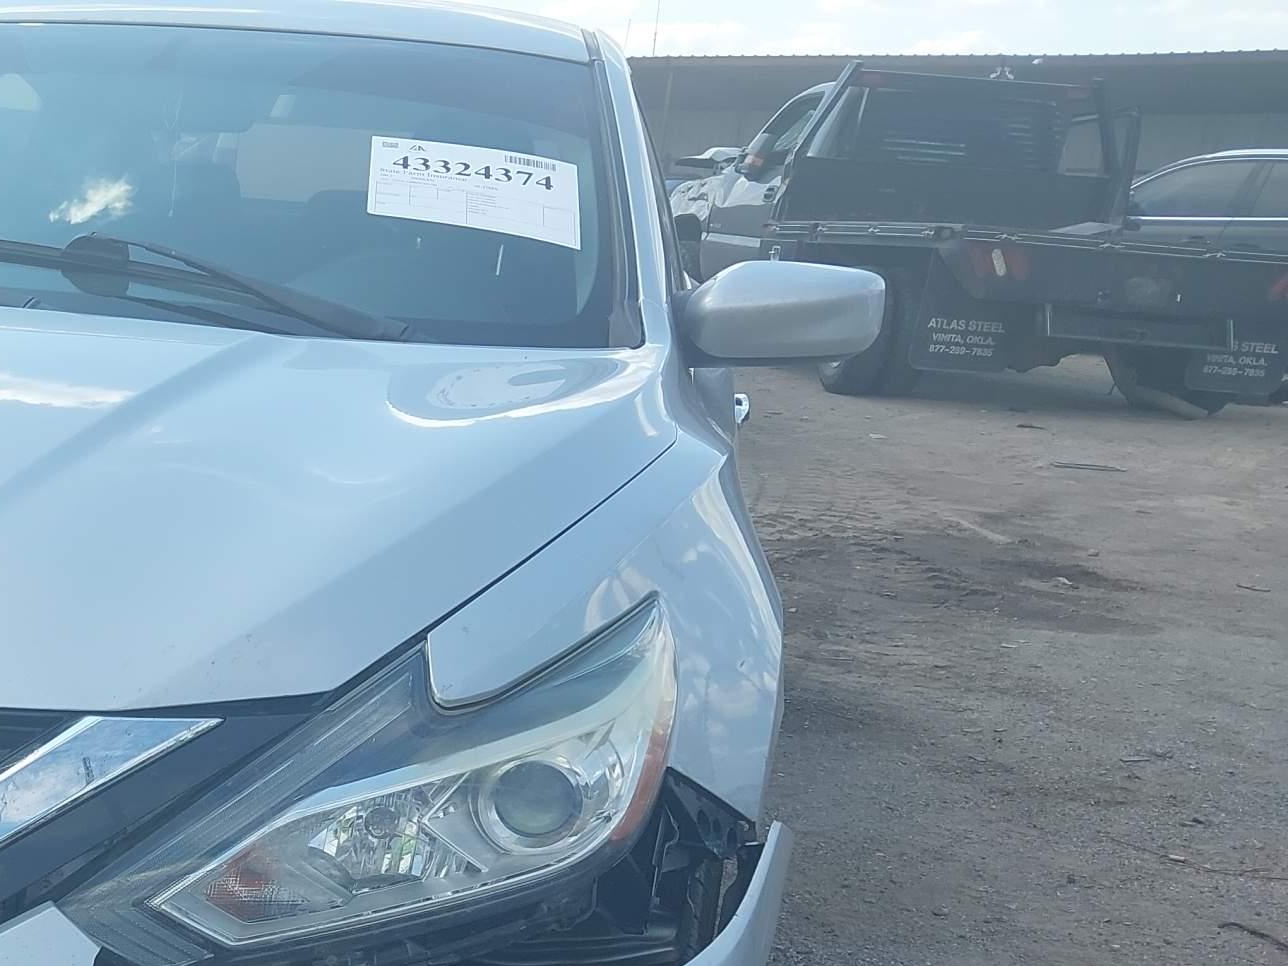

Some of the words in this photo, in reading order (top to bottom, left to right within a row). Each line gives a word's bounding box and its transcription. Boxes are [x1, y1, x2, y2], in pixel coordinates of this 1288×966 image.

[392, 155, 554, 191] 43324374
[928, 317, 966, 331] ATLAS
[967, 319, 1006, 333] STEEL
[1240, 342, 1279, 354] STEEL
